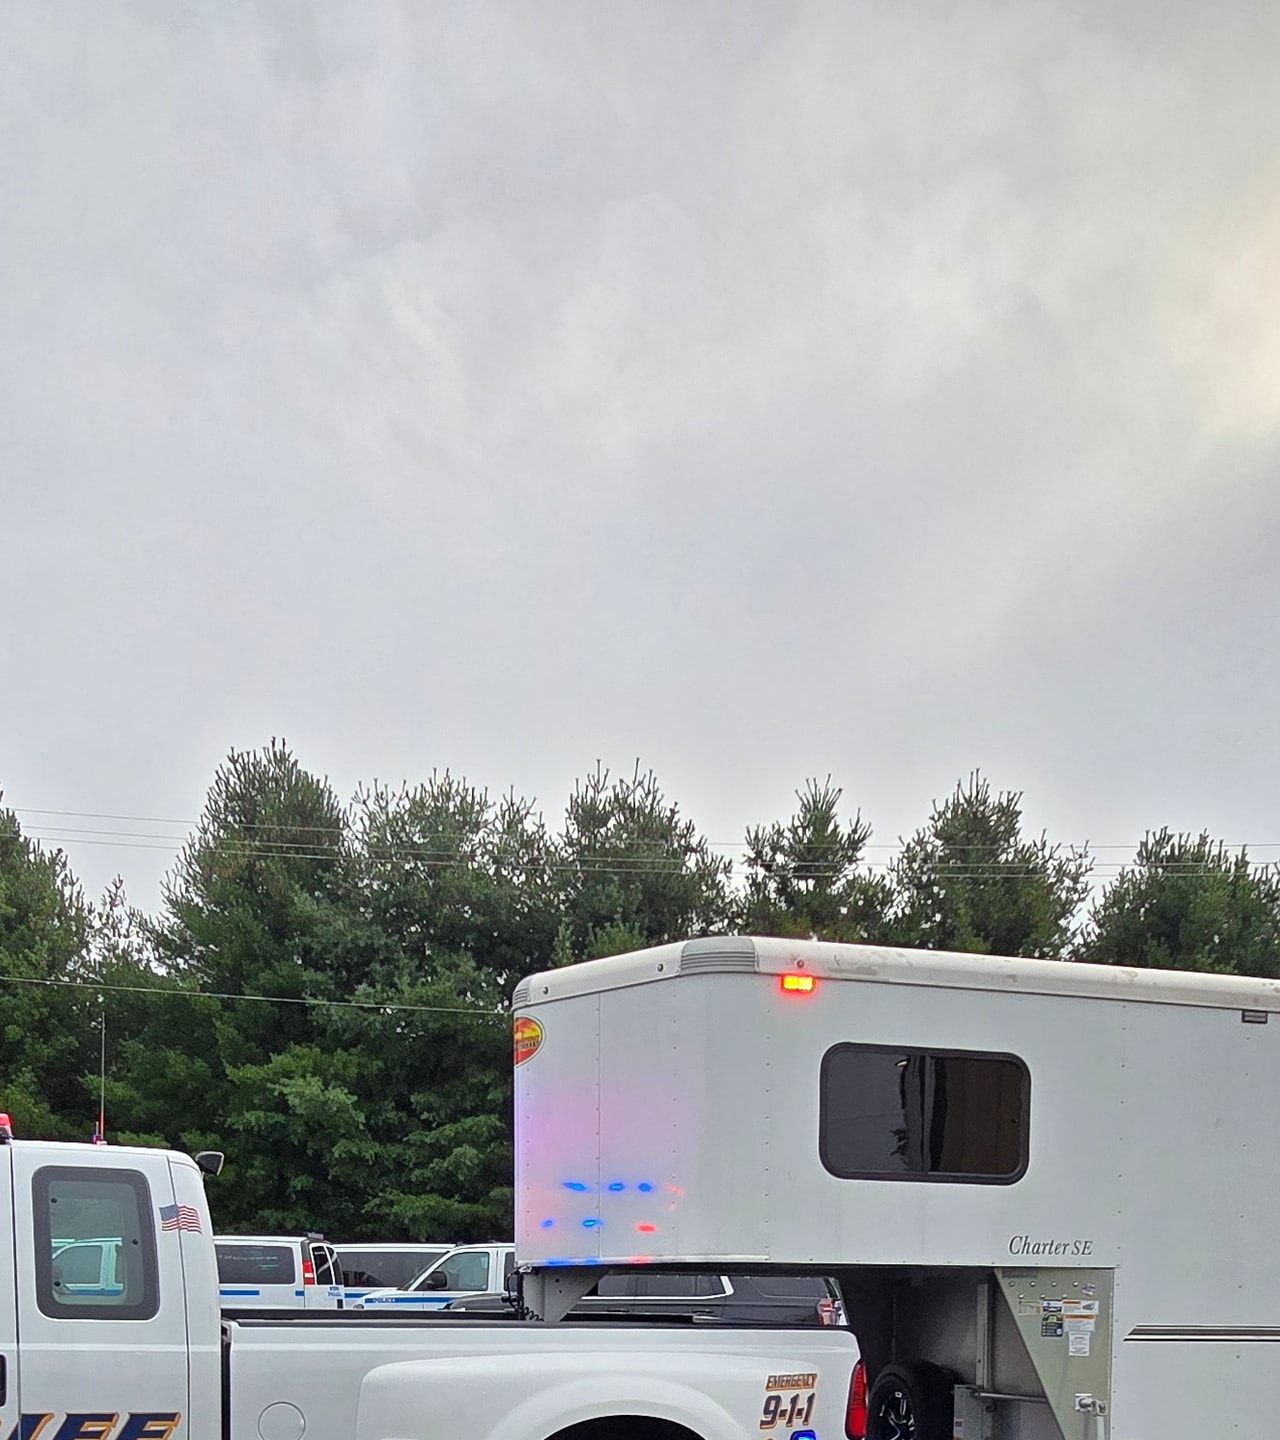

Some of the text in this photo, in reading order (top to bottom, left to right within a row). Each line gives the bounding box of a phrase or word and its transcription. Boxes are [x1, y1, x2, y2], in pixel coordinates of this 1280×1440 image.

[1008, 1235, 1093, 1256] Charter SE
[765, 1372, 818, 1392] EMERGENCY
[759, 1392, 816, 1430] 9-1-1
